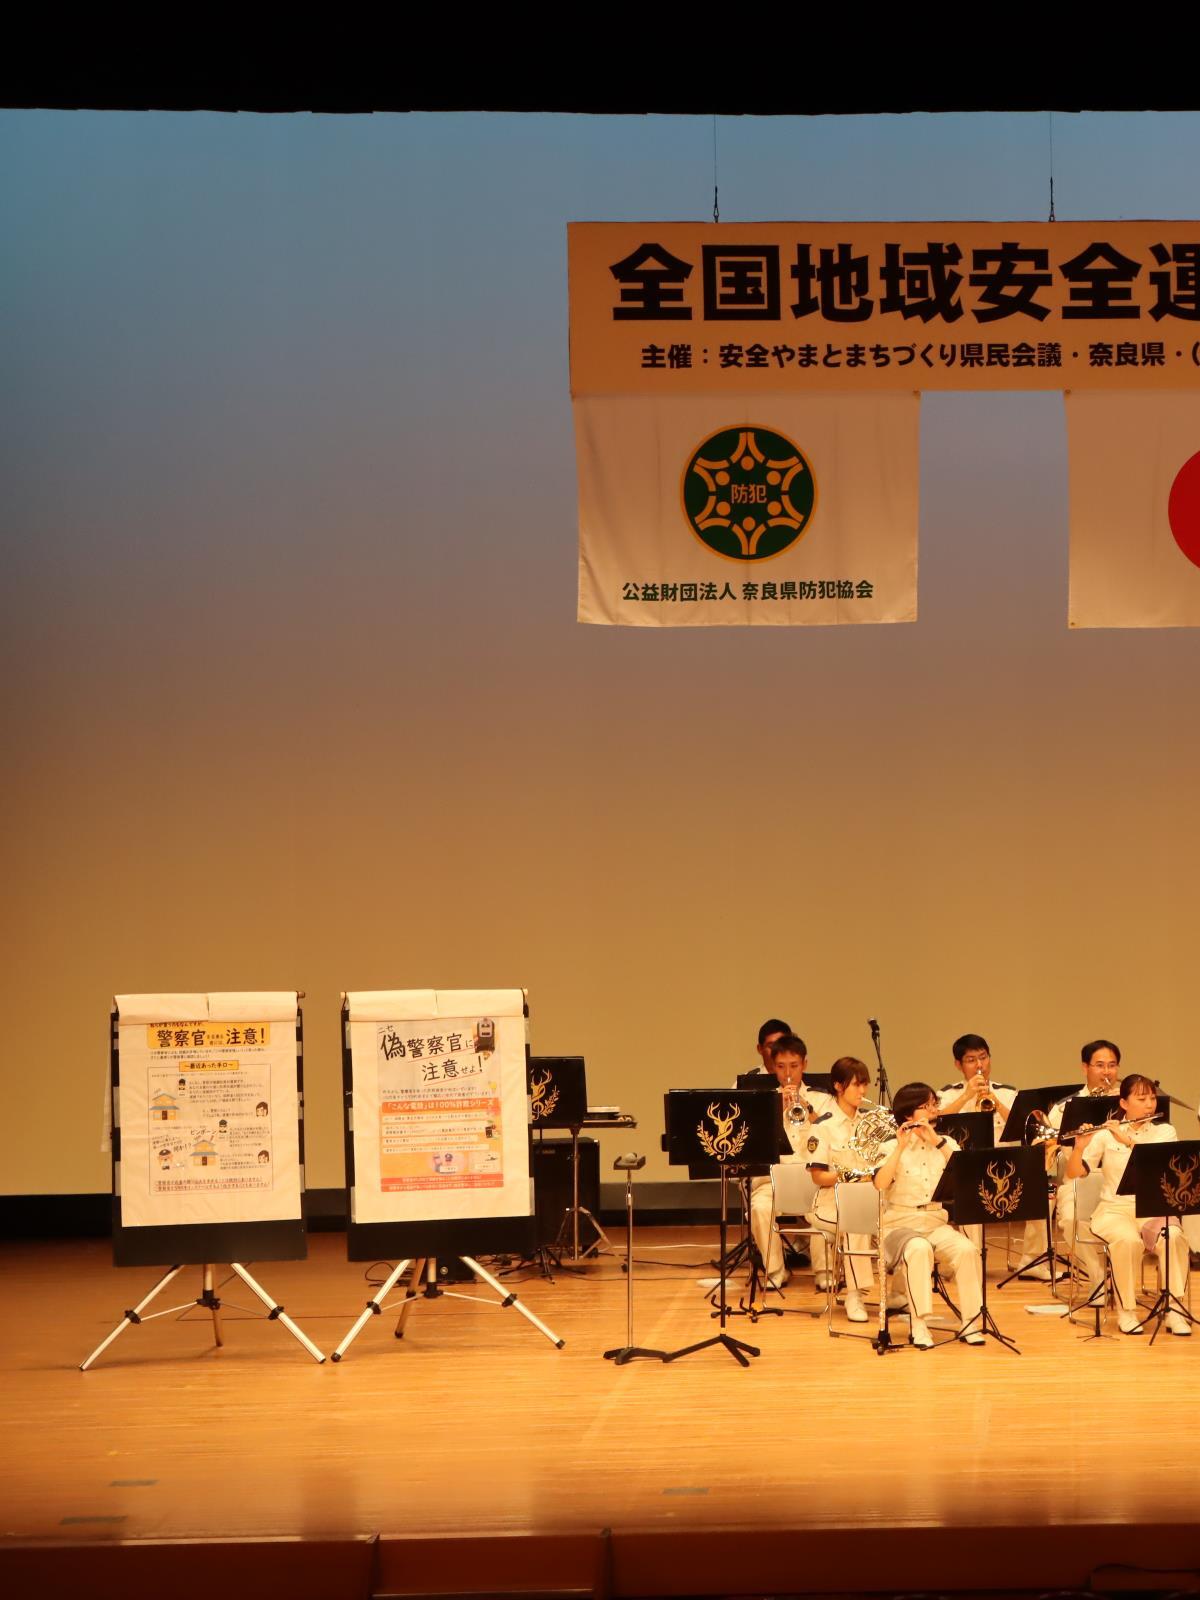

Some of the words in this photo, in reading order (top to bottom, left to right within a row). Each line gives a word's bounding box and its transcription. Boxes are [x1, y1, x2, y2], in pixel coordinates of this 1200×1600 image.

[730, 483, 768, 504] 防犯
[622, 582, 737, 602] 公益財団法人
[741, 579, 874, 601] 奈良県防犯協会
[157, 1029, 206, 1048] 警察官
